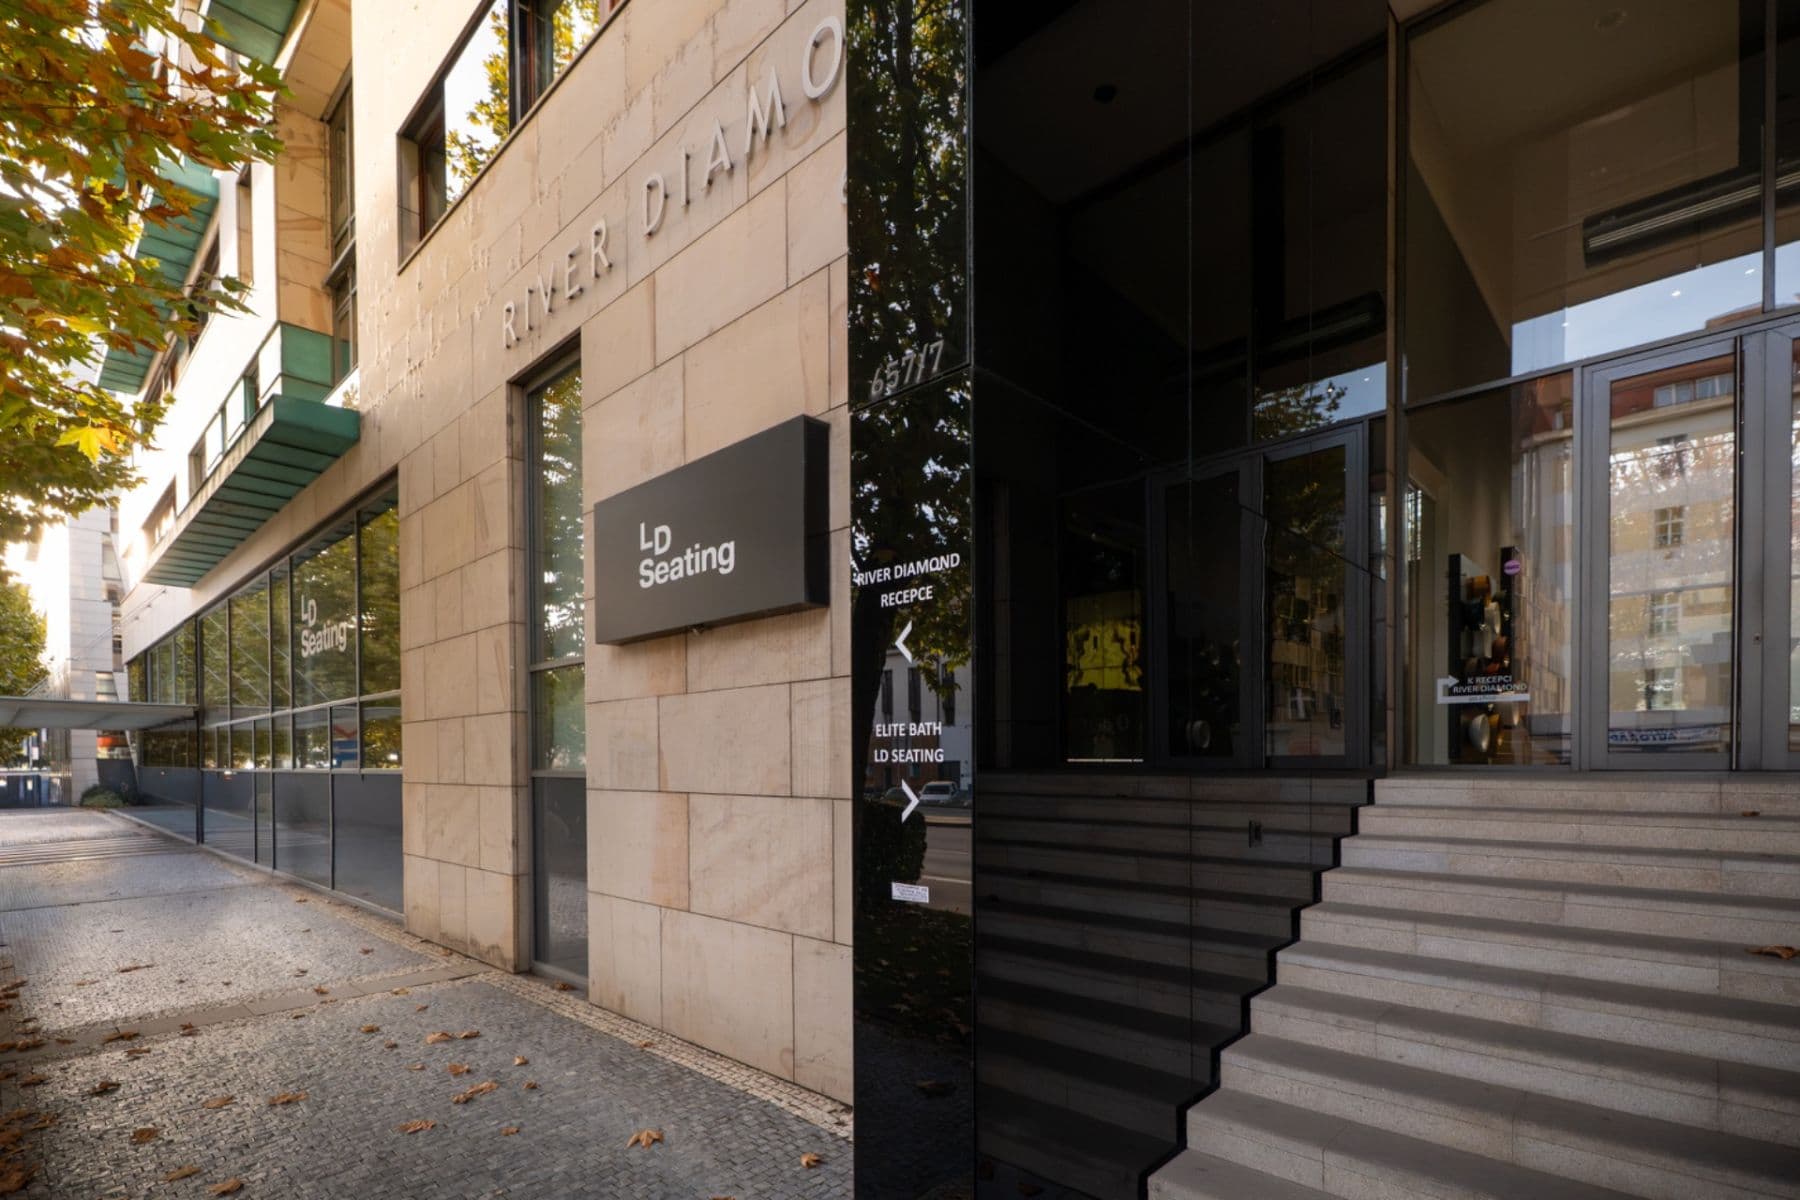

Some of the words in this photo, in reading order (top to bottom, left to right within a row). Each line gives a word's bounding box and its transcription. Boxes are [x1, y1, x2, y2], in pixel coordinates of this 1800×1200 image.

[503, 218, 613, 350] RIVER
[871, 339, 944, 397] 657/7
[640, 522, 672, 556] LD
[639, 540, 735, 589] Seating
[857, 567, 892, 587] RIVER
[894, 552, 961, 580] DIAMOND
[301, 595, 317, 627] LD
[880, 585, 934, 608] RECEPCE
[301, 620, 348, 658] Seating
[1453, 685, 1478, 694] RIVER
[1480, 683, 1528, 693] DIAMOND
[875, 723, 906, 738] ELITE
[908, 721, 942, 737] BATH
[874, 749, 889, 763] LD
[891, 748, 945, 763] SEATING
